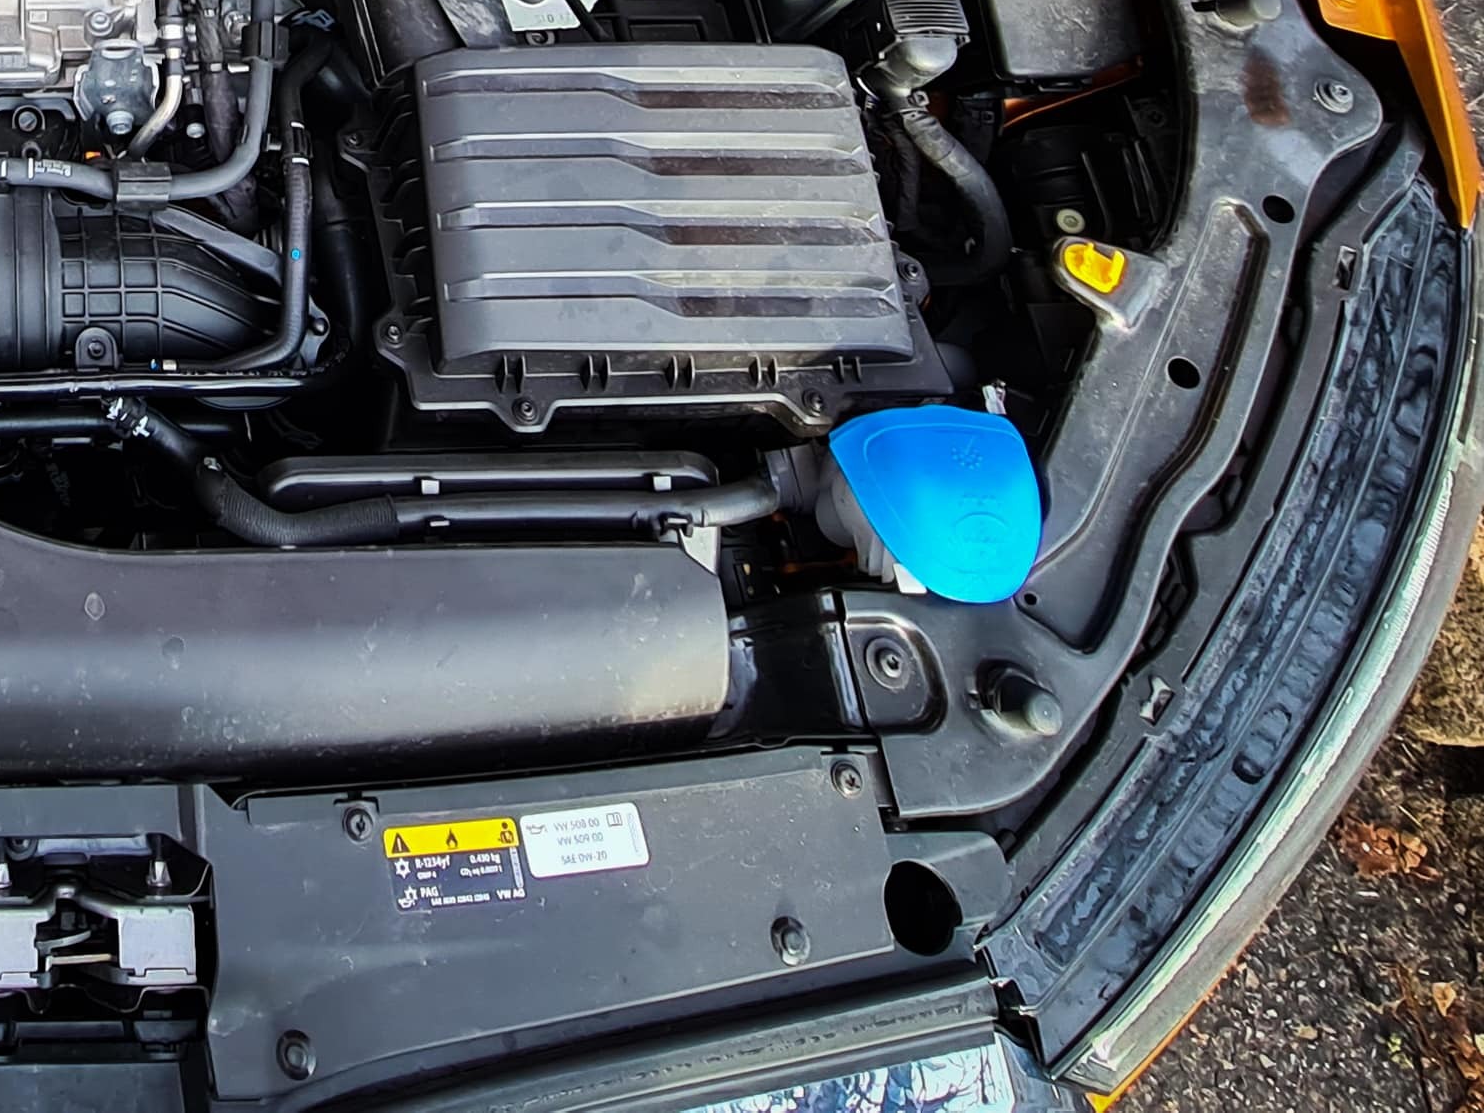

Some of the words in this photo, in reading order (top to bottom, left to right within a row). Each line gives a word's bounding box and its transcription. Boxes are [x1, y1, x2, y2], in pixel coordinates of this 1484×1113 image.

[553, 821, 568, 832] VW
[570, 819, 587, 830] 508
[588, 817, 600, 828] 00
[557, 836, 572, 846] VW
[574, 833, 590, 844] 509
[591, 832, 604, 842] 00
[415, 855, 451, 869] R-1234yf
[420, 886, 439, 898] PAG
[496, 889, 512, 900] VW
